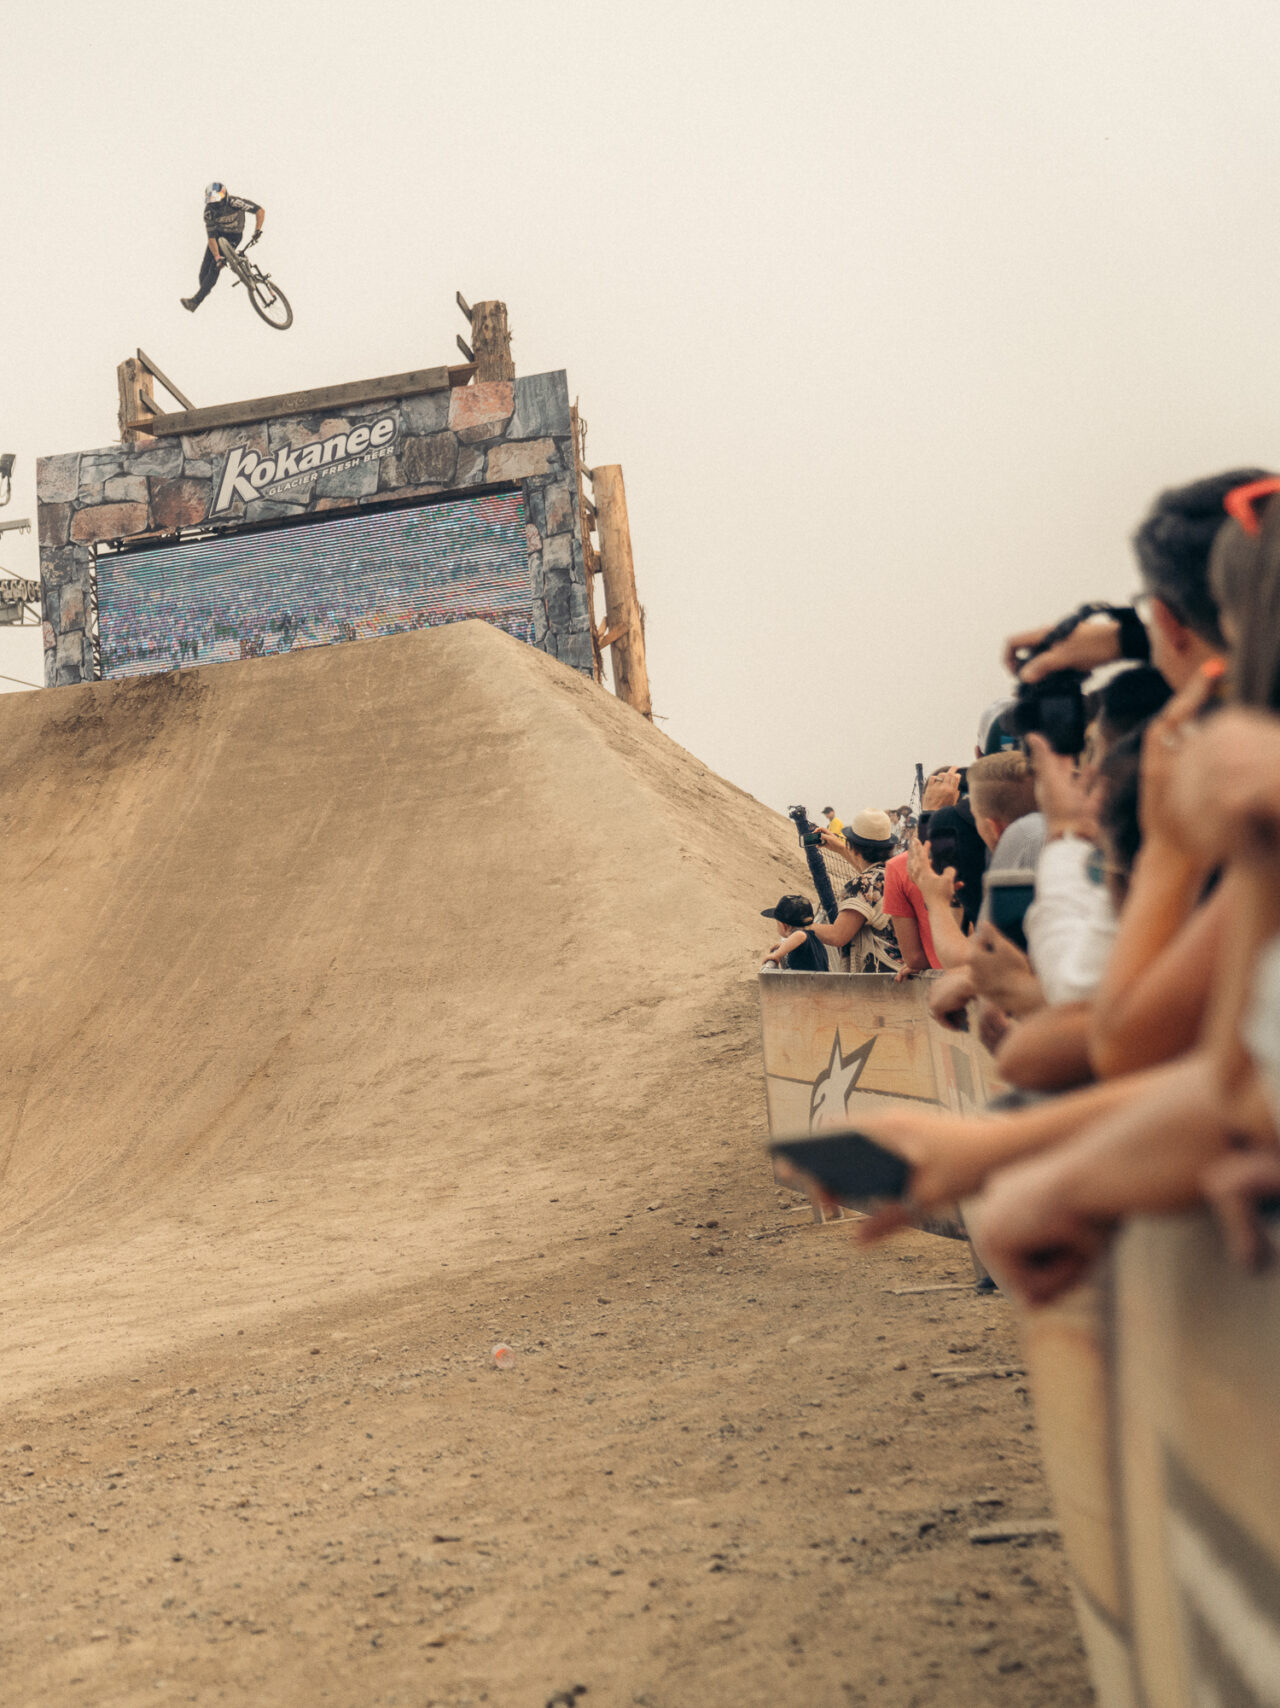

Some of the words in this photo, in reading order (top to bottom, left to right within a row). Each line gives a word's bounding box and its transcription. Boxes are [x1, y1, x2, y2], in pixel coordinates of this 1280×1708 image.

[212, 417, 396, 514] Kokanee
[268, 472, 319, 496] GLACIER
[321, 457, 361, 478] FRESH
[363, 445, 395, 464] BEER
